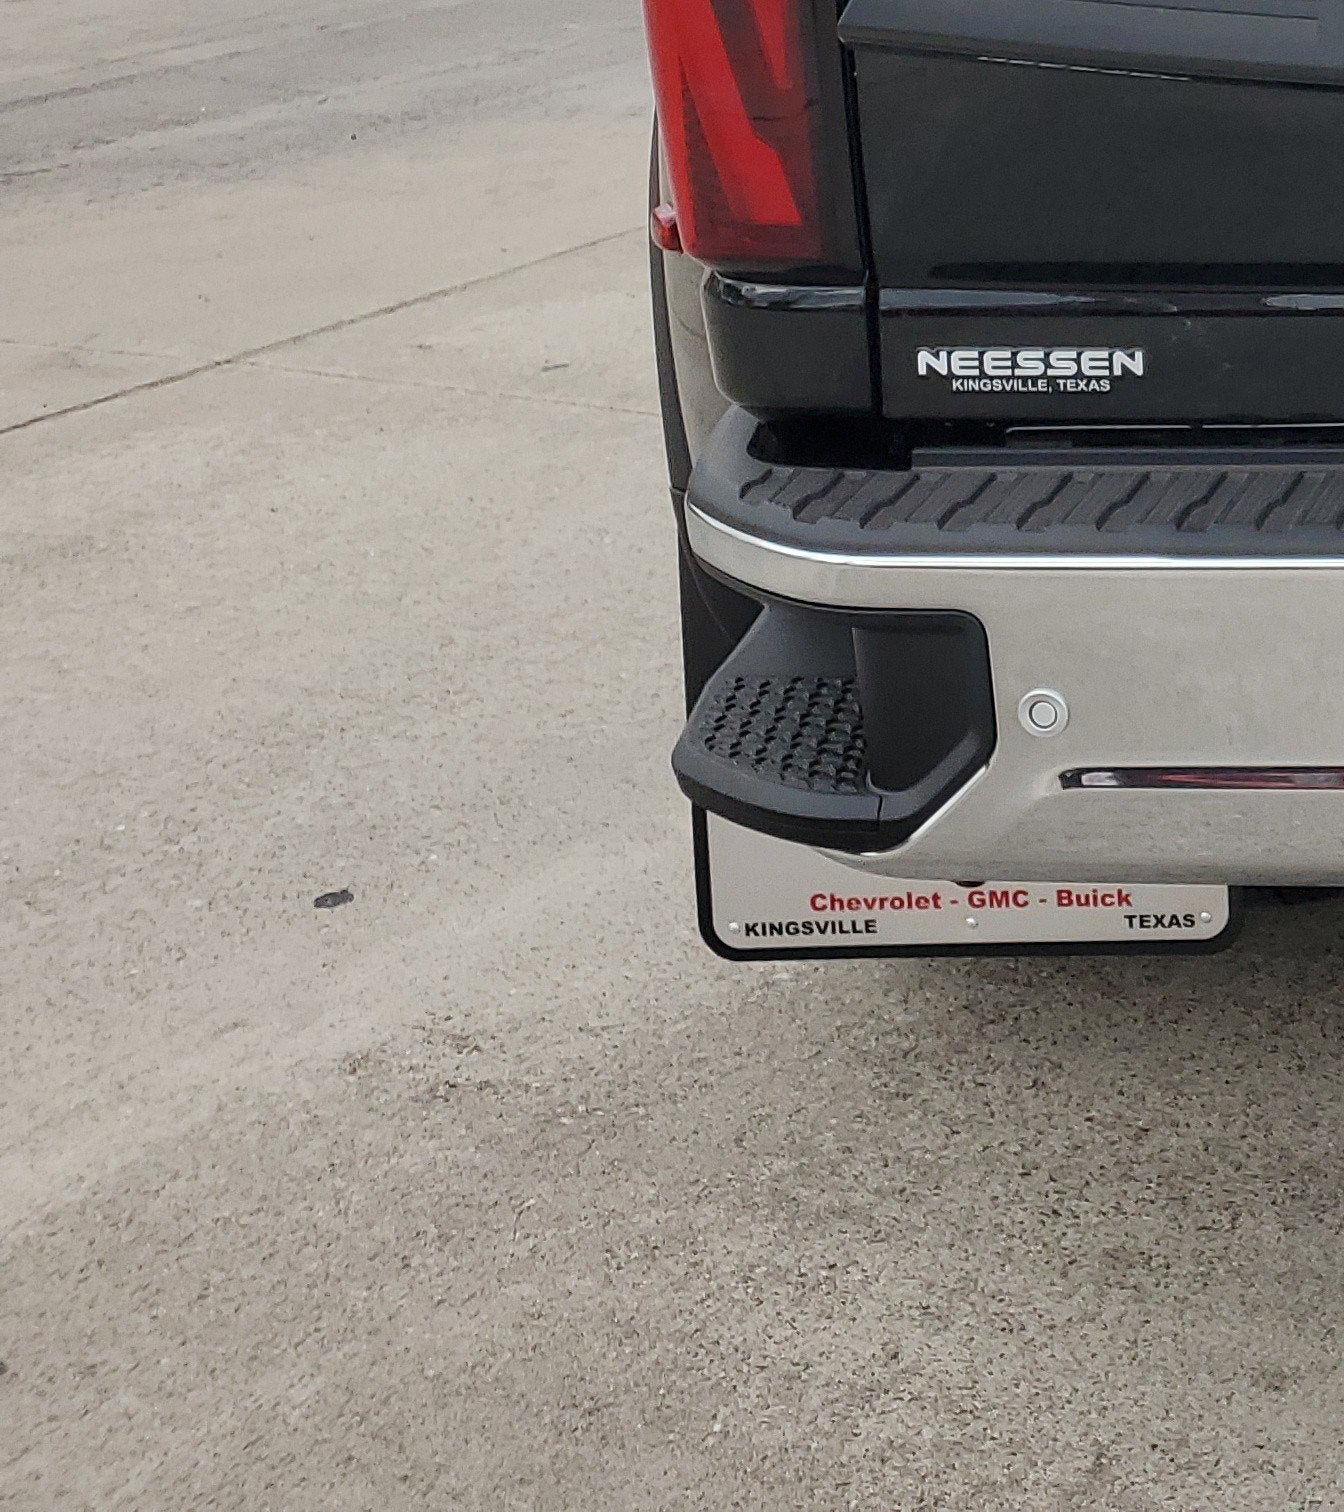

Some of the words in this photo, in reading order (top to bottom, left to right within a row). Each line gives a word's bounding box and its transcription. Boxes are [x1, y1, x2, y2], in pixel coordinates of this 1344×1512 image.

[916, 348, 1145, 377] NEESSEN
[951, 378, 1053, 394] KINGSVILLE,
[1056, 378, 1112, 393] TEXAS
[809, 891, 943, 912] Chevrolet
[967, 889, 1030, 909] GMC
[1056, 888, 1134, 909] Buick
[744, 919, 879, 938] KINGSVILLE
[1123, 913, 1197, 930] TEXAS
